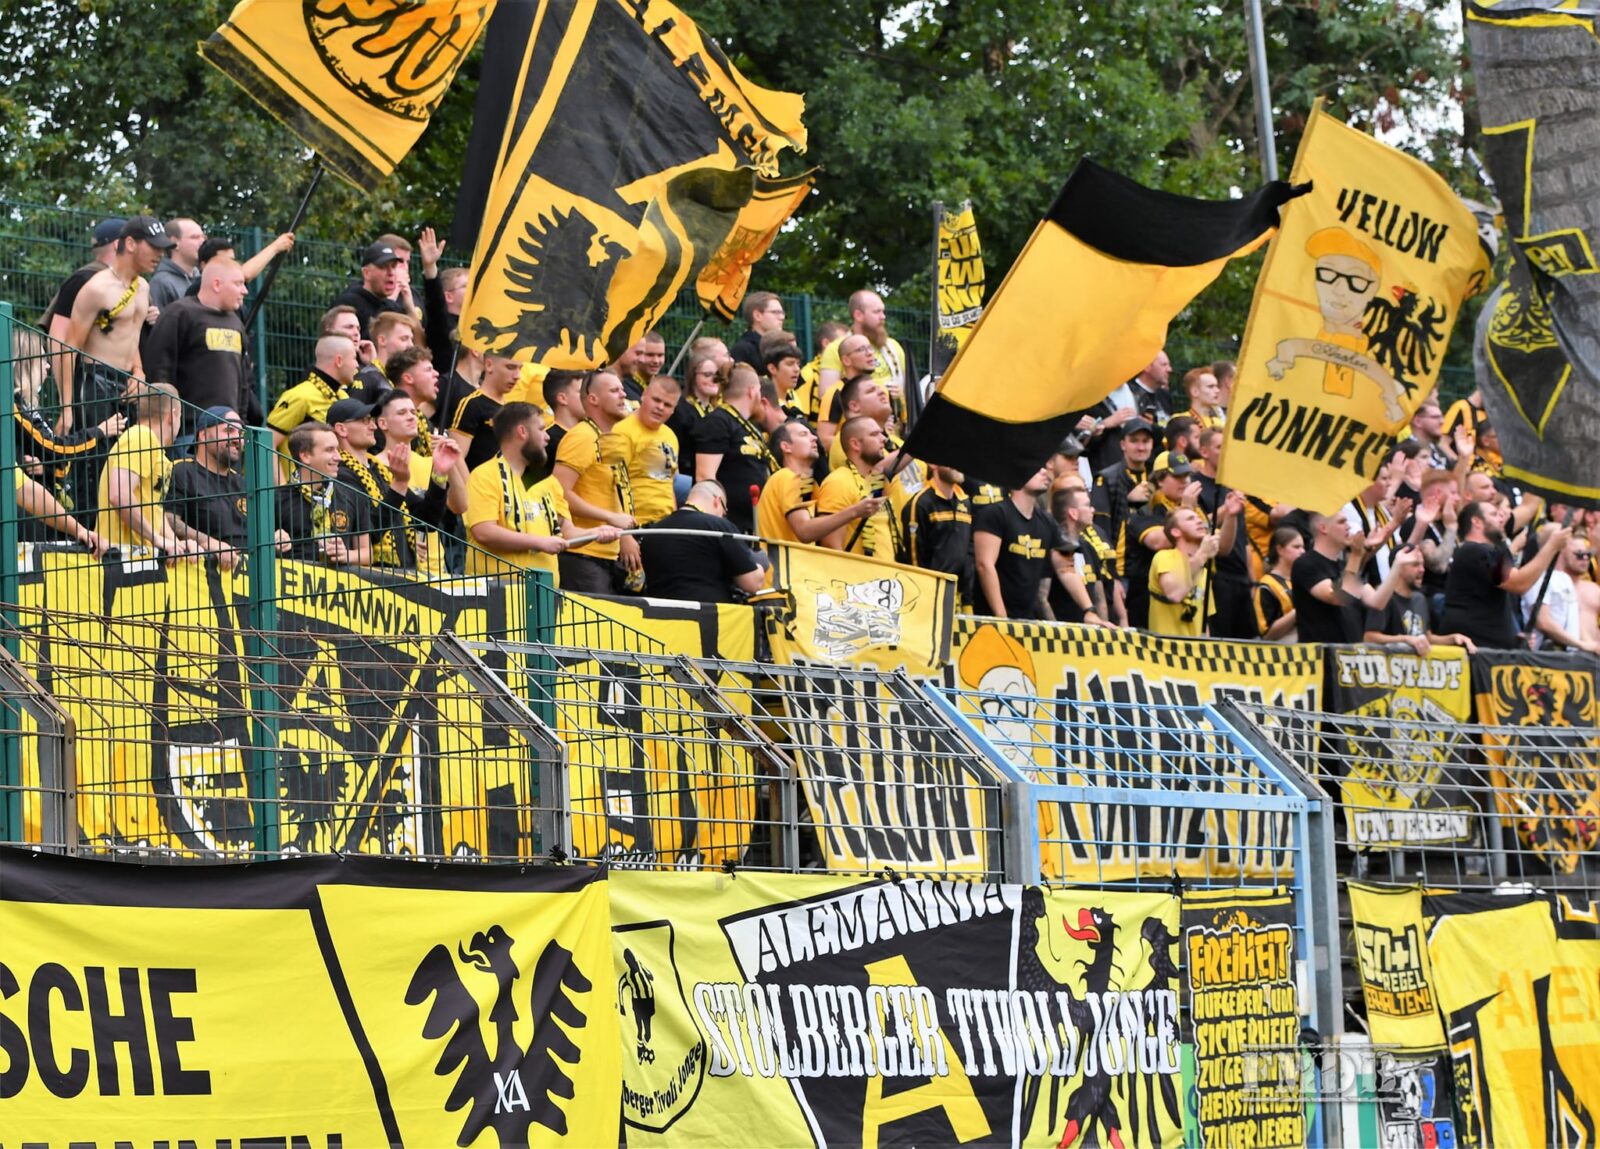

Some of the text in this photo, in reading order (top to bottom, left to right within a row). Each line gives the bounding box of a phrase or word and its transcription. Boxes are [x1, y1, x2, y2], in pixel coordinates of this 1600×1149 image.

[1336, 188, 1449, 264] YELLOW
[233, 561, 421, 639] AEMANNIA
[1390, 657, 1462, 689] STADT
[754, 879, 1005, 974] ALEMANNIA
[1271, 986, 1294, 1014] UM
[1381, 969, 1427, 993] REGEL
[692, 981, 1182, 1078] STOLBERGER TIVOLI JONGE
[1197, 1016, 1297, 1057] SICHERHEIT
[653, 1077, 678, 1114] Tivoli
[678, 1041, 701, 1093] Jonge
[1199, 1057, 1222, 1088] ZU
